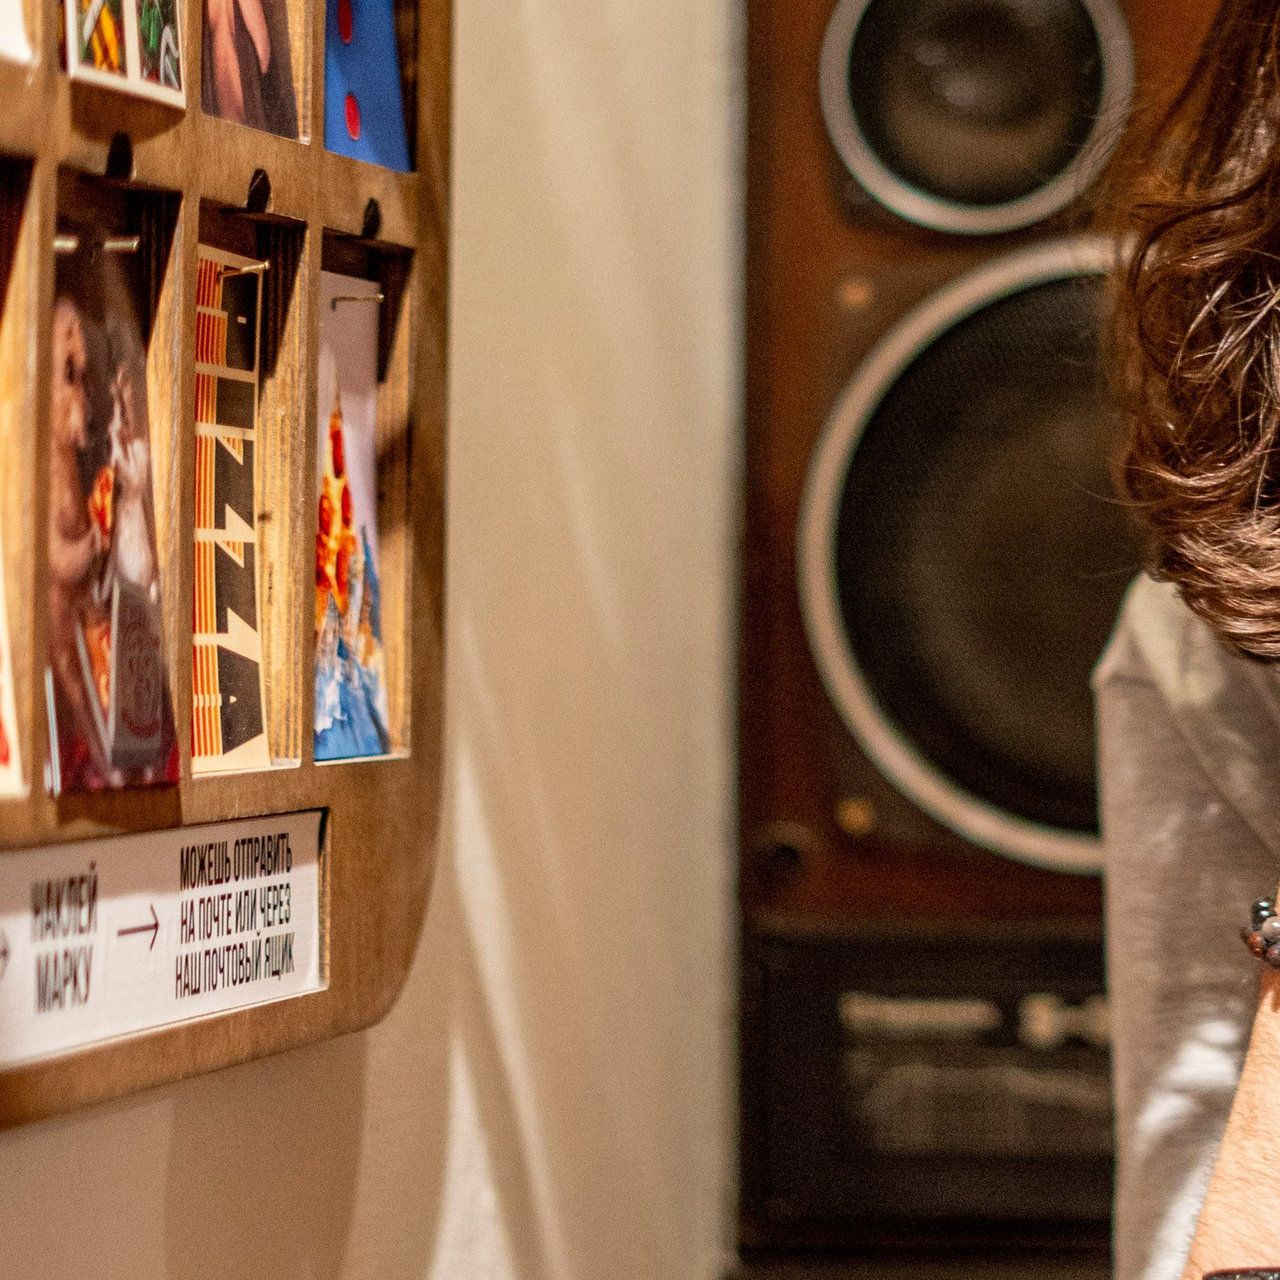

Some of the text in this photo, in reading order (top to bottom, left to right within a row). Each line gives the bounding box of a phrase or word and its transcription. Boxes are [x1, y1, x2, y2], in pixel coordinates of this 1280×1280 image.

[194, 257, 264, 759] PIZZA
[180, 832, 293, 891] МОЖЕШЬ ОТПРАВИТЬ
[30, 860, 99, 943] НАКЛЕЙ
[180, 882, 292, 945] НА ПОЧТЕ ИЛИ ЧЕРЕЗ
[36, 944, 94, 1013] МАРКУ
[175, 932, 296, 1000] НАШ ПОЧТОВЫЙ ЯЩИК
